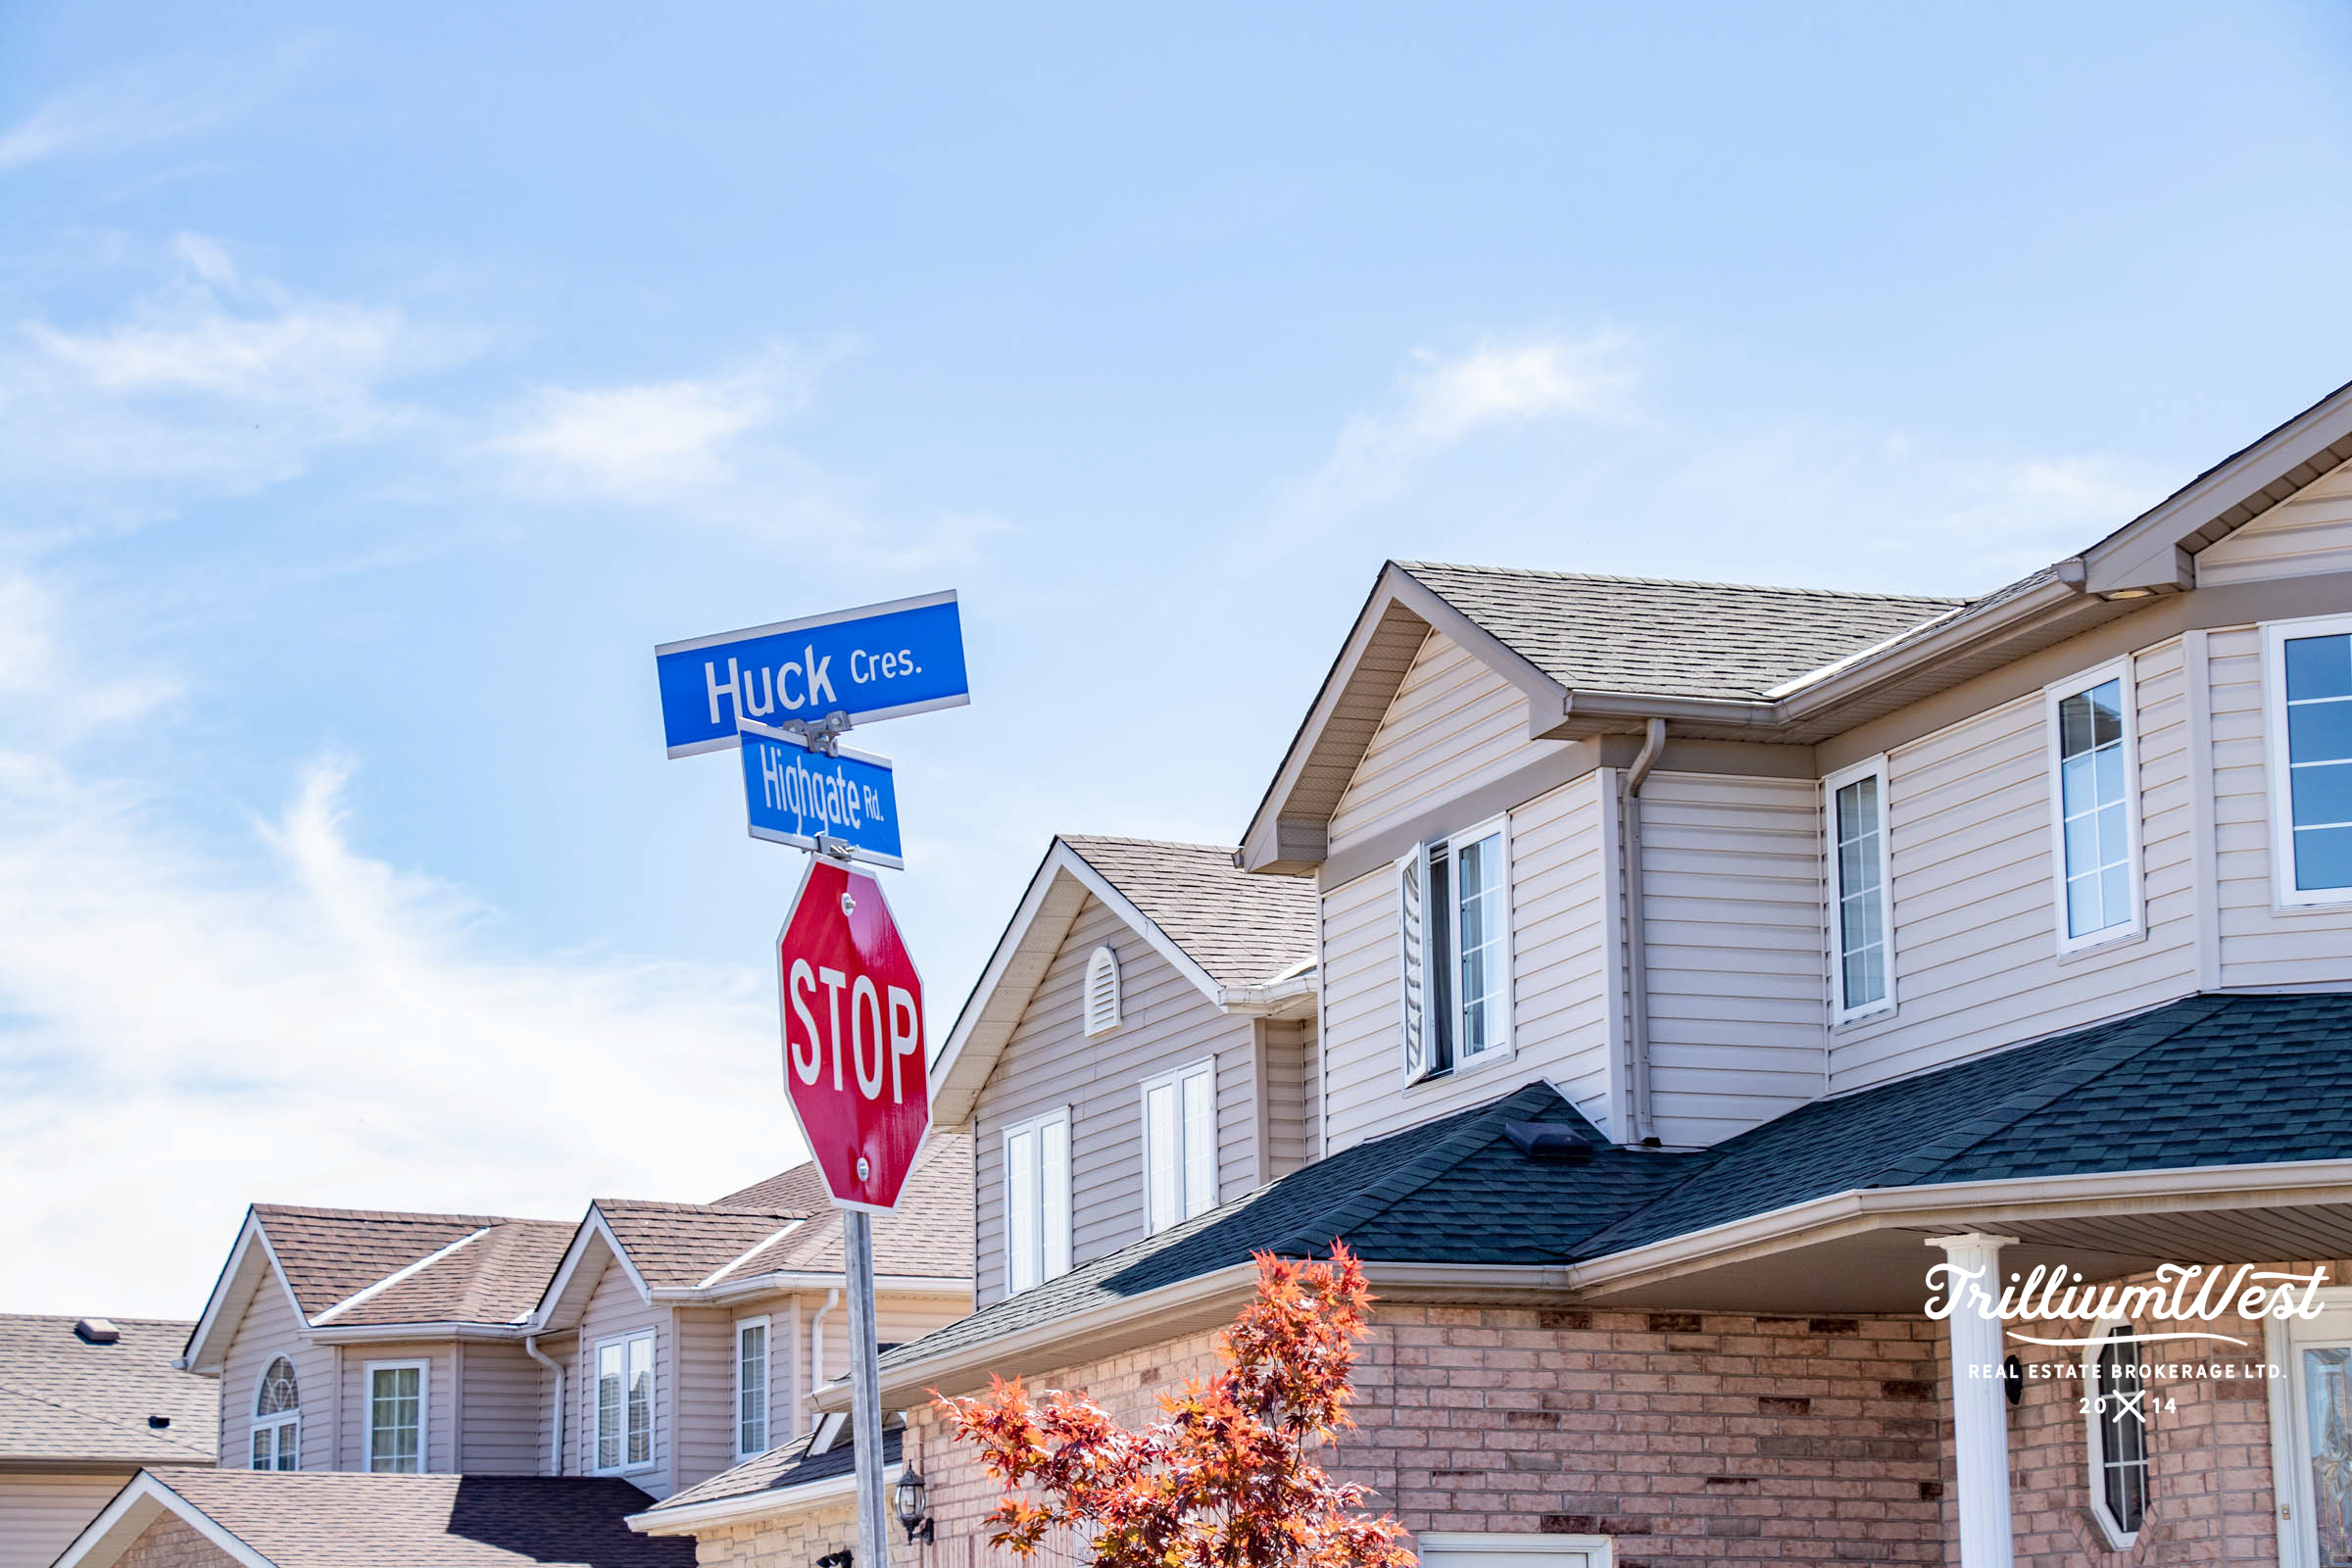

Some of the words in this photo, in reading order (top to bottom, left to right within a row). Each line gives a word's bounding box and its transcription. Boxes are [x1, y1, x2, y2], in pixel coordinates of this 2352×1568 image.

[705, 644, 837, 724] Huck
[850, 649, 922, 684] Cres.
[760, 744, 861, 836] Highgate
[863, 785, 884, 821] Rd.
[789, 957, 918, 1104] STOP
